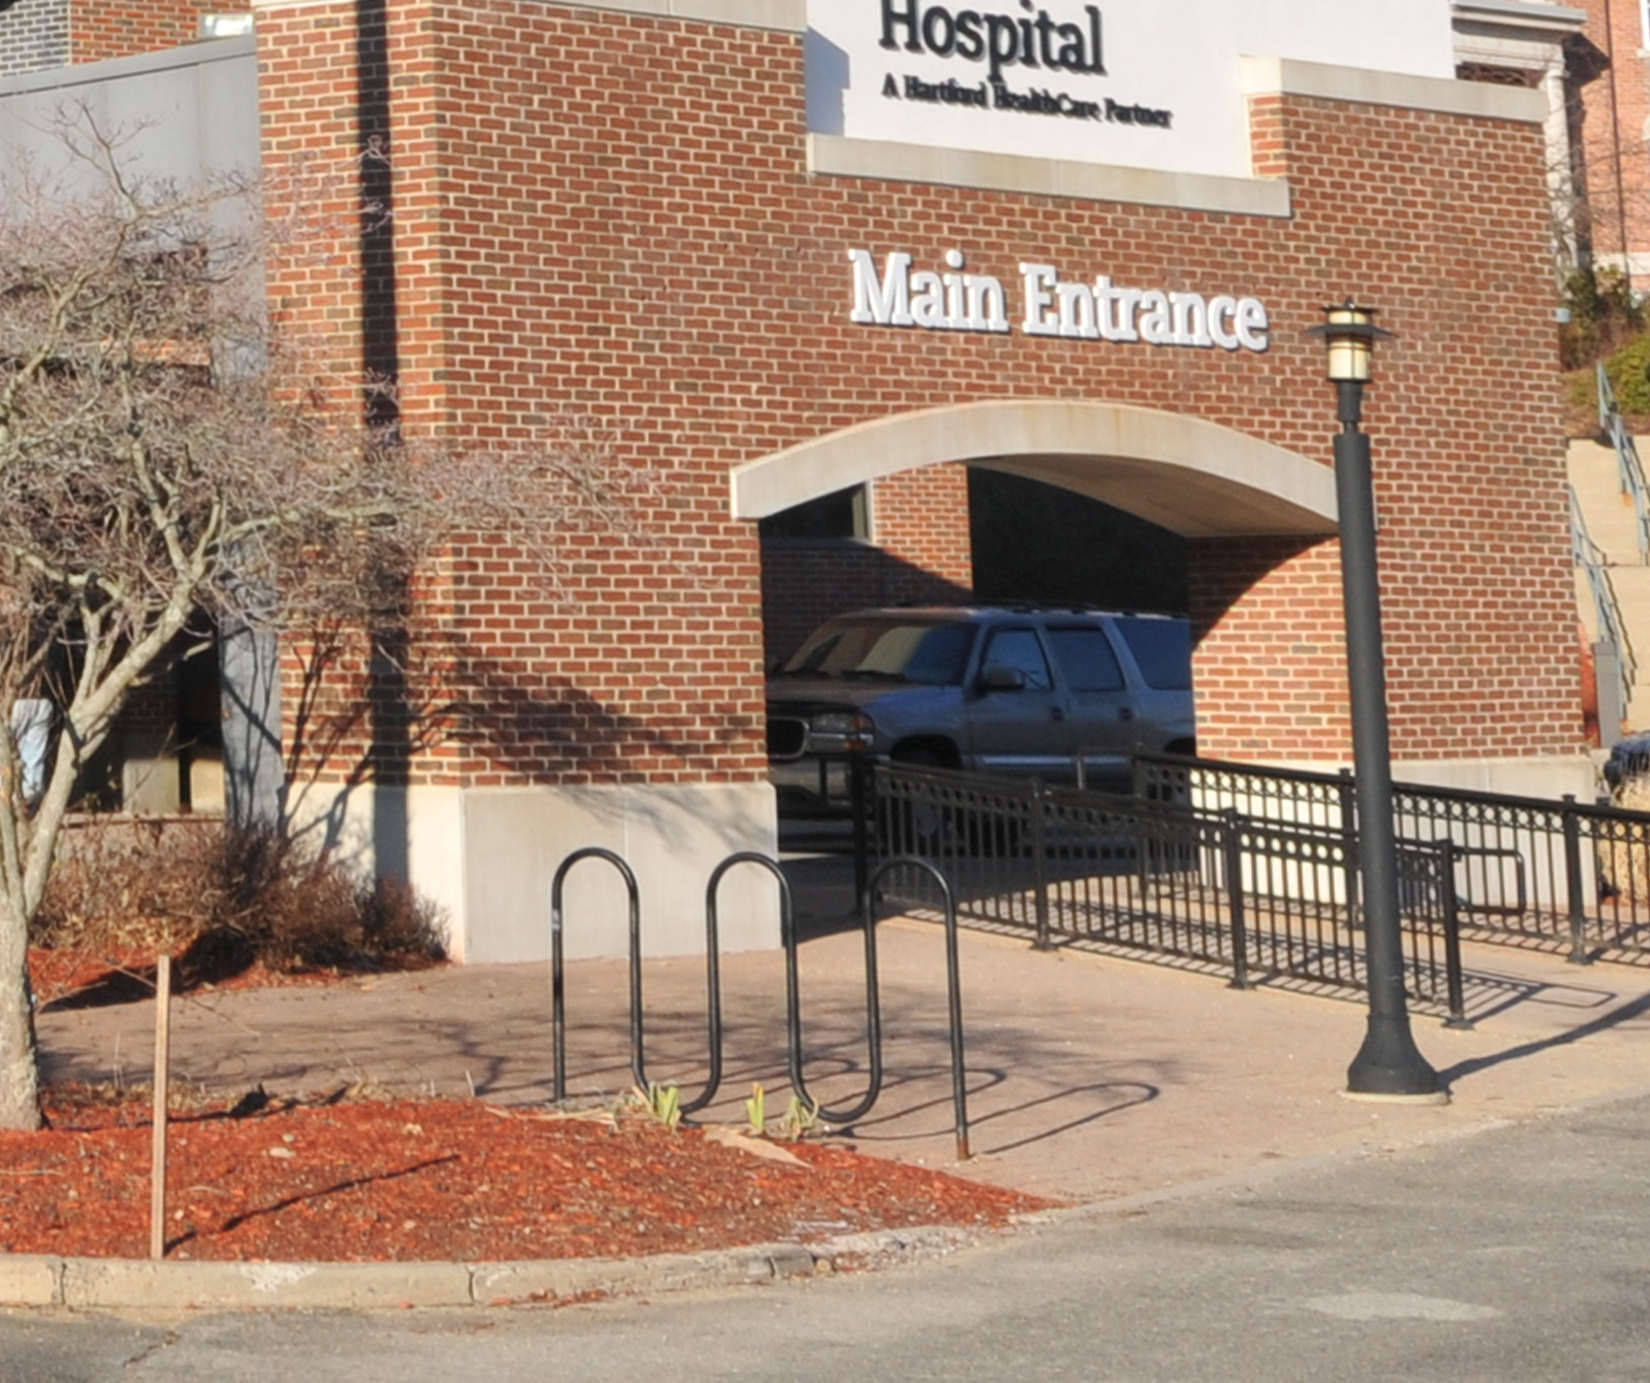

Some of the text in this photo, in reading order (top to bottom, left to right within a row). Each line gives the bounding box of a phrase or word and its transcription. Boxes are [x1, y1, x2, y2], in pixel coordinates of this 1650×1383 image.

[881, 72, 1173, 129] A Hartford HealthCare Partner
[848, 248, 1269, 352] Main Entrance
